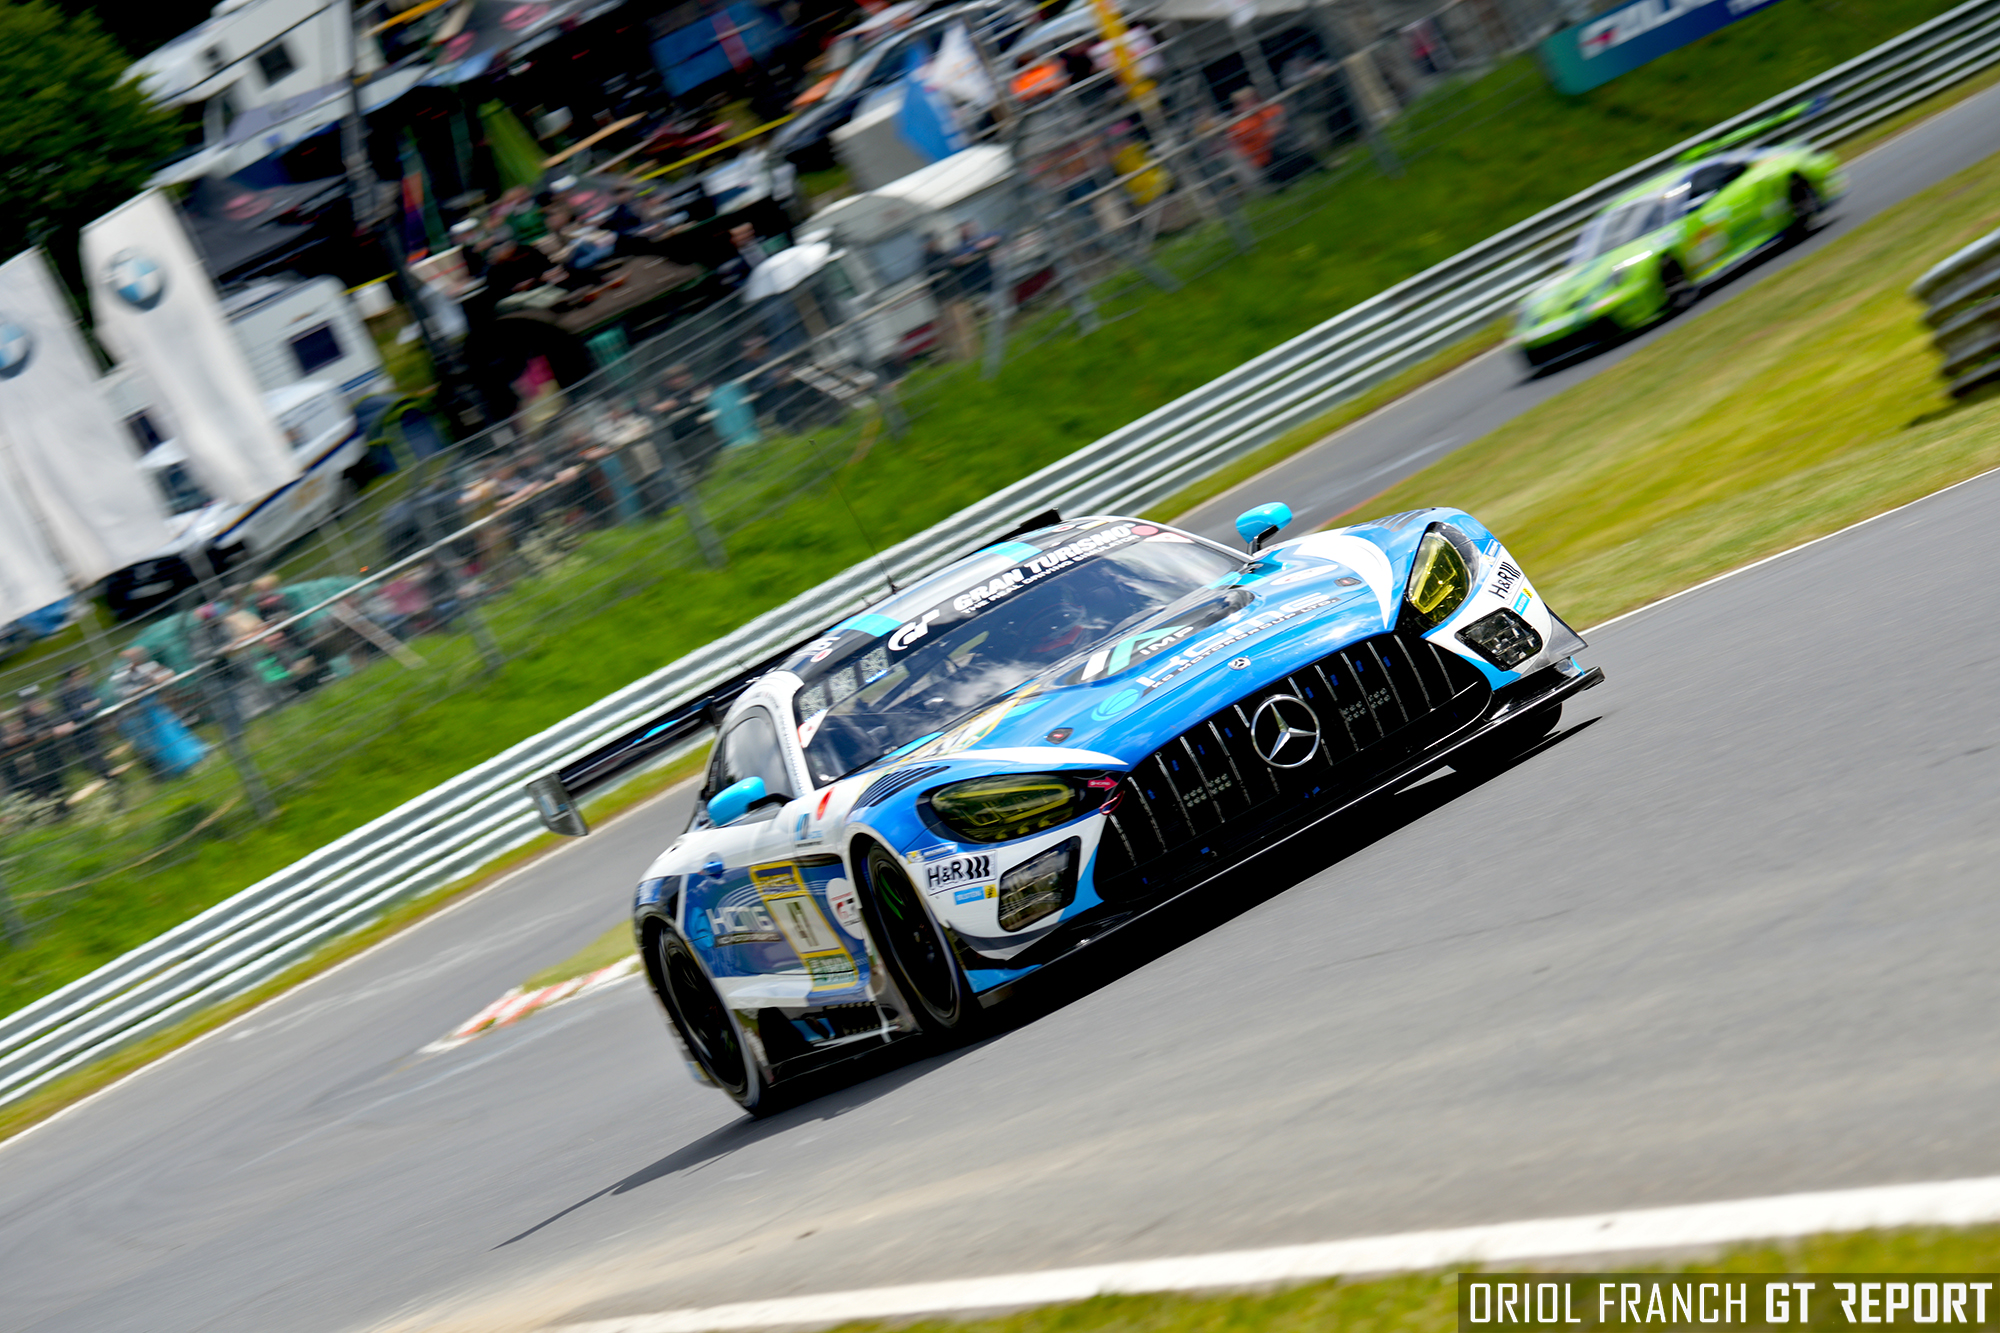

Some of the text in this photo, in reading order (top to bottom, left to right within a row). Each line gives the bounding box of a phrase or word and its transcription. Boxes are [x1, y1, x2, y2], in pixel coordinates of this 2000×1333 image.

[953, 524, 1132, 611] GRAN TURISMO
[960, 600, 990, 614] THE
[988, 584, 1024, 601] REAL
[1021, 560, 1075, 585] DRIVING
[1488, 571, 1516, 599] H&R
[1135, 591, 1332, 687] KCMG
[1139, 626, 1194, 656] IMP
[1177, 612, 1297, 673] MOTORGROUP
[927, 860, 963, 888] H&R
